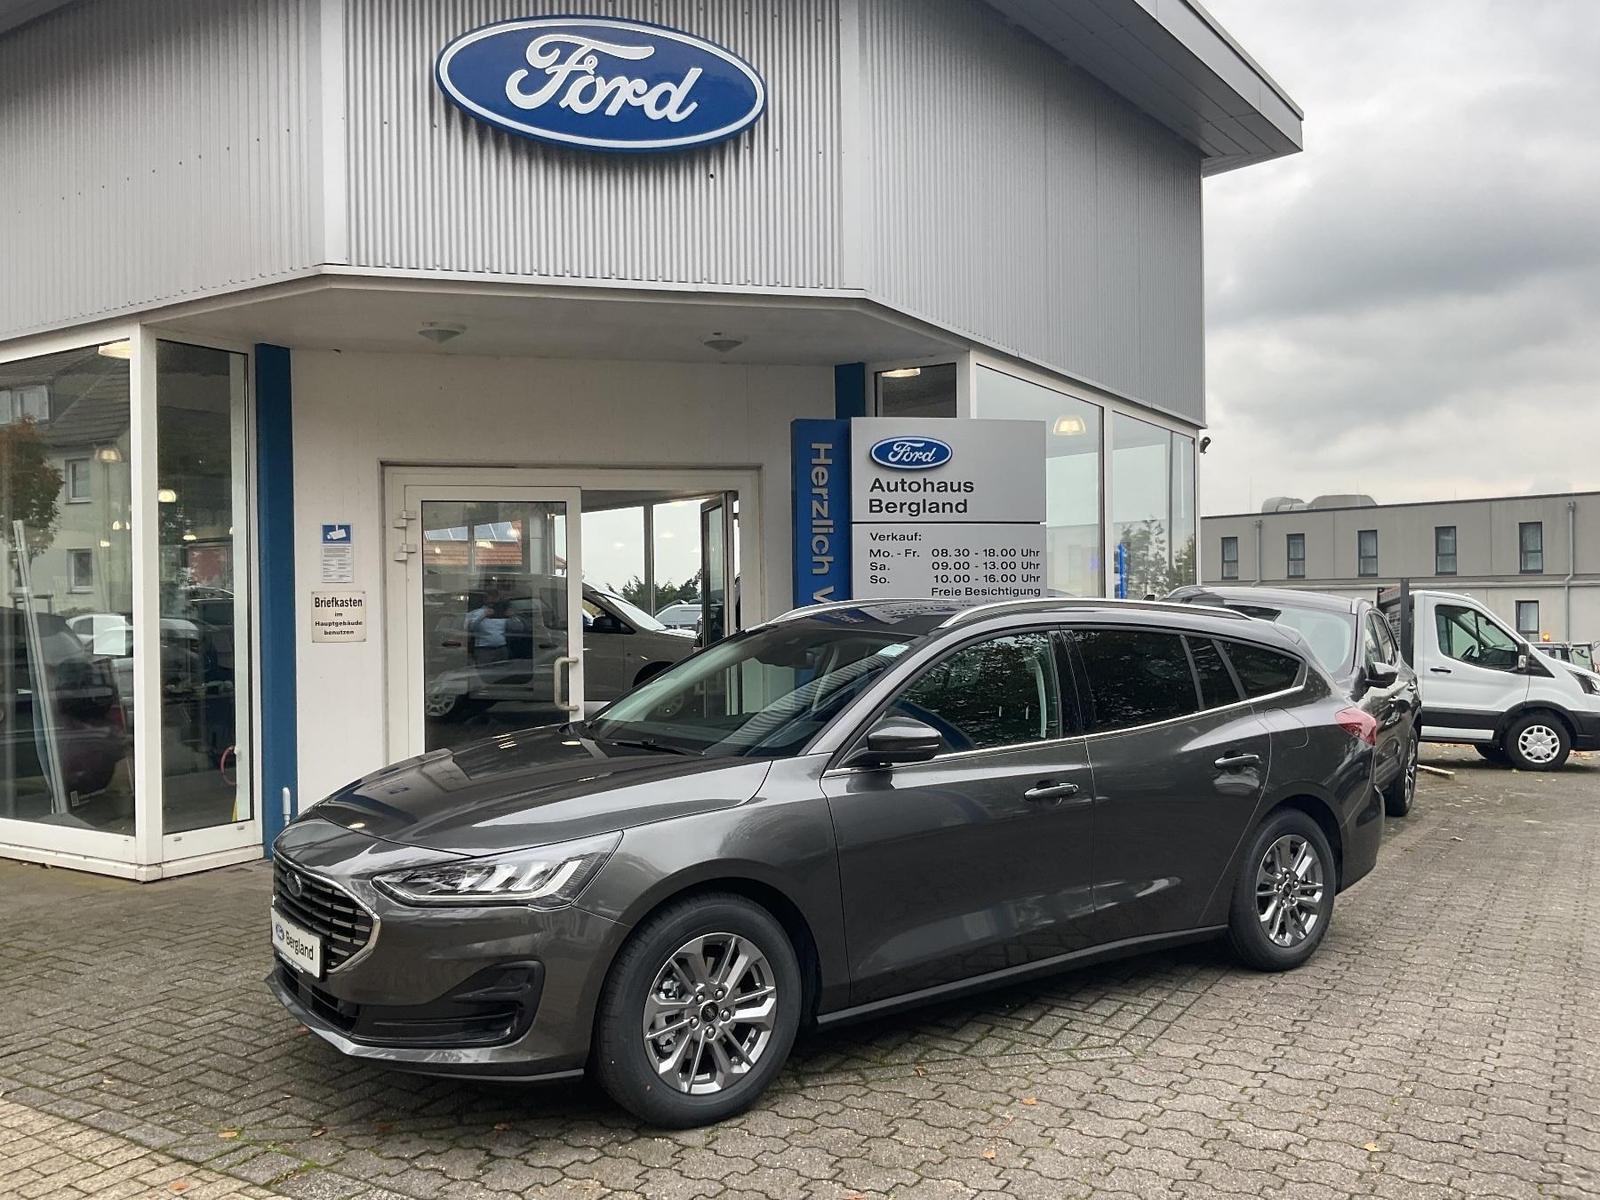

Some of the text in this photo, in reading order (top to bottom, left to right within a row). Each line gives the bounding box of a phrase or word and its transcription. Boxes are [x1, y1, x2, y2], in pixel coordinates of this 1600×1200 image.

[505, 34, 702, 122] Ford
[887, 441, 937, 463] Ford
[869, 478, 975, 494] Autohaus
[811, 443, 834, 575] Herzlich
[868, 498, 968, 517] Bergland
[870, 532, 922, 541] Verkauf:
[869, 549, 894, 558] Mo.
[904, 549, 920, 558] Fr.
[931, 548, 970, 557] 08.30
[982, 548, 1017, 557] 18.00
[1021, 548, 1041, 557] Uhr
[870, 561, 891, 571] Sa.
[931, 561, 970, 570] 09.00
[982, 561, 1017, 570] 13.00
[1021, 561, 1041, 570] Uhr
[870, 574, 891, 584] So.
[933, 574, 970, 583] 10.00
[982, 574, 1017, 583] 16.00
[1021, 574, 1041, 583] Uhr
[931, 586, 1041, 598] Freie Besichtigung
[314, 597, 363, 608] Briefkasten
[286, 930, 314, 960] Bergland
